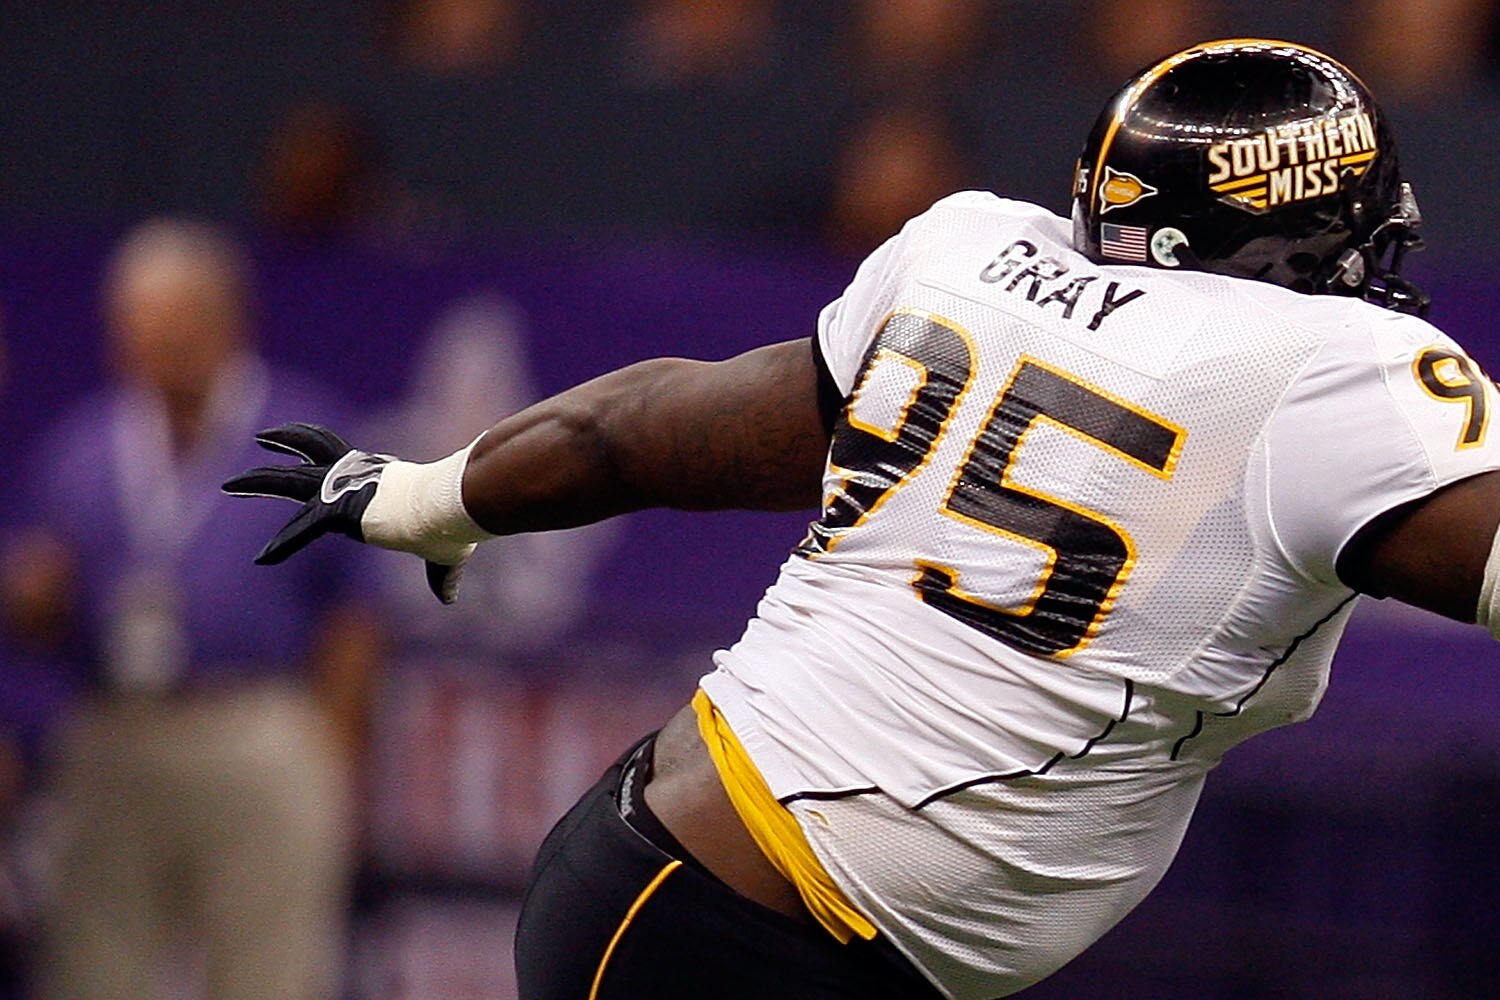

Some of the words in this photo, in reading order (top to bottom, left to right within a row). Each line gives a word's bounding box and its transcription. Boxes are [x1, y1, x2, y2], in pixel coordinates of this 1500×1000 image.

[1207, 112, 1376, 183] SOUTHERN
[1269, 158, 1339, 206] MISS
[979, 239, 1146, 332] GRAY
[795, 308, 1188, 660] 95
